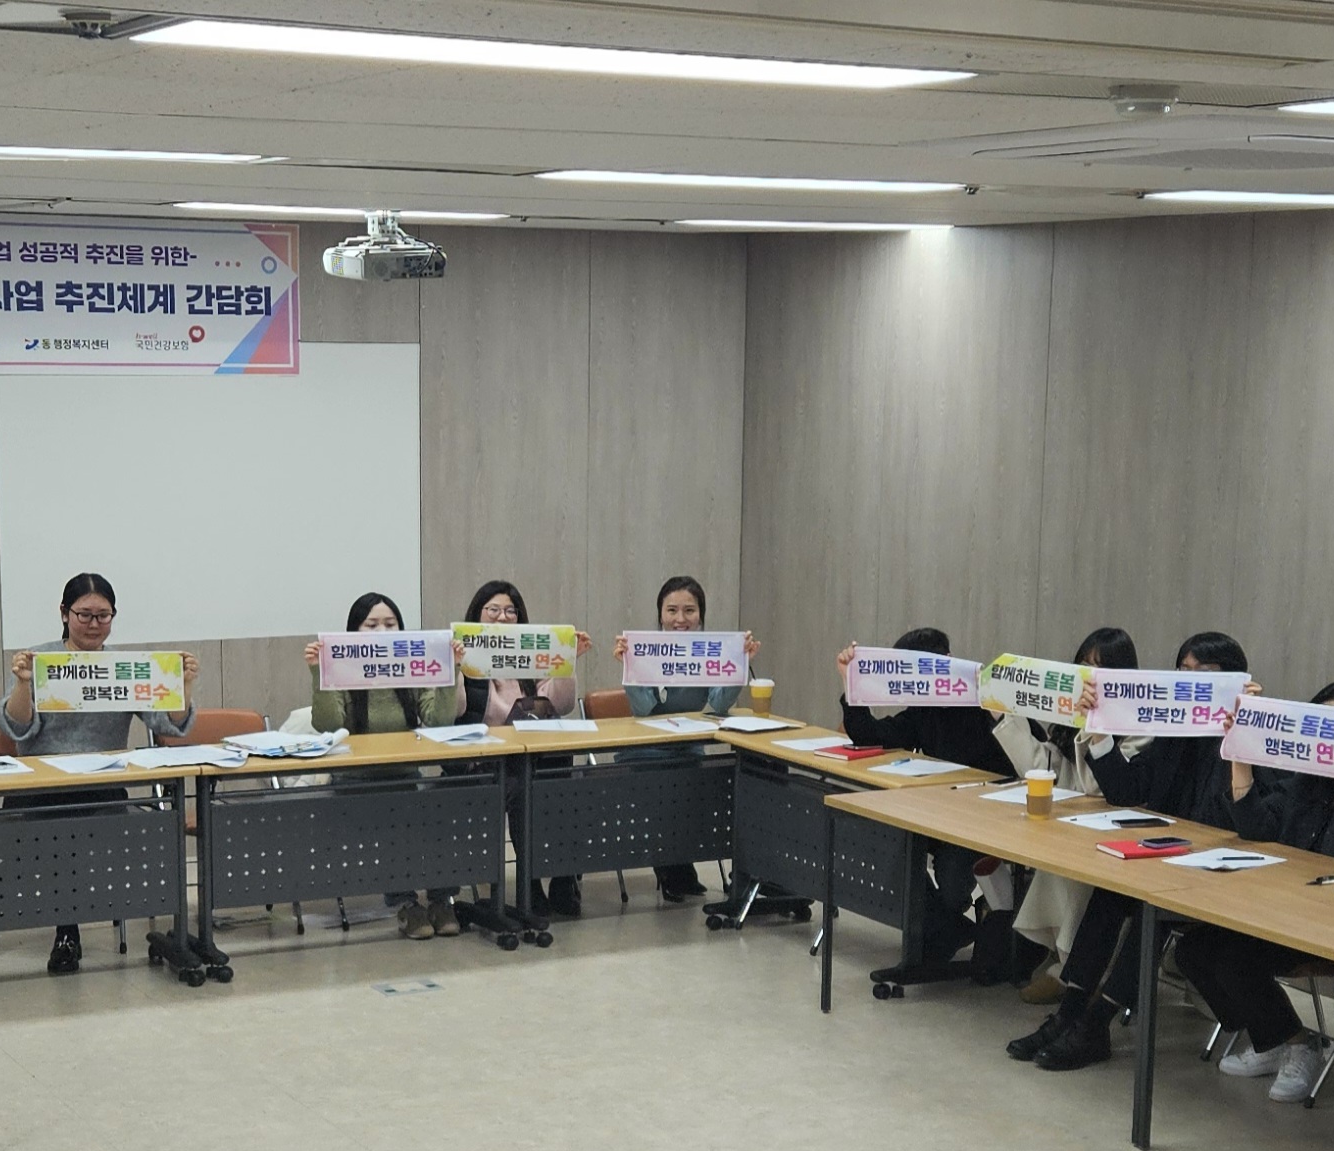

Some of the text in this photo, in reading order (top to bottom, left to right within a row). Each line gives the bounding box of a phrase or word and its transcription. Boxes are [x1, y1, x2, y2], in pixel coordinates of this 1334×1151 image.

[19, 241, 78, 263] 성공적
[86, 243, 144, 265] 추진을
[55, 280, 175, 314] 추진체계
[186, 284, 272, 316] 간담회
[54, 339, 109, 350] 행정복지센터
[135, 339, 189, 351] 국민건강보험
[331, 639, 426, 659] 함께하는 돌봄
[462, 633, 551, 650] 함께하는 돌봄
[634, 640, 722, 658] 함께하는 돌봄
[47, 662, 151, 681] 함께하는 돌봄
[363, 659, 442, 678] 행복한 연수
[491, 654, 566, 671] 행복한 연수
[662, 659, 737, 677] 행복한 연수
[857, 657, 951, 676] 함께하는 돌봄
[888, 678, 968, 697] 행복한 연수
[991, 664, 1075, 693] 함께하는 돌봄
[82, 682, 170, 702] 행복한 연수
[1103, 681, 1213, 702] 함께하는 돌봄
[1015, 690, 1078, 716] 행복한 연
[1137, 705, 1187, 725] 행복한
[1237, 707, 1296, 733] 함께하는
[1265, 736, 1312, 759] 행복한
